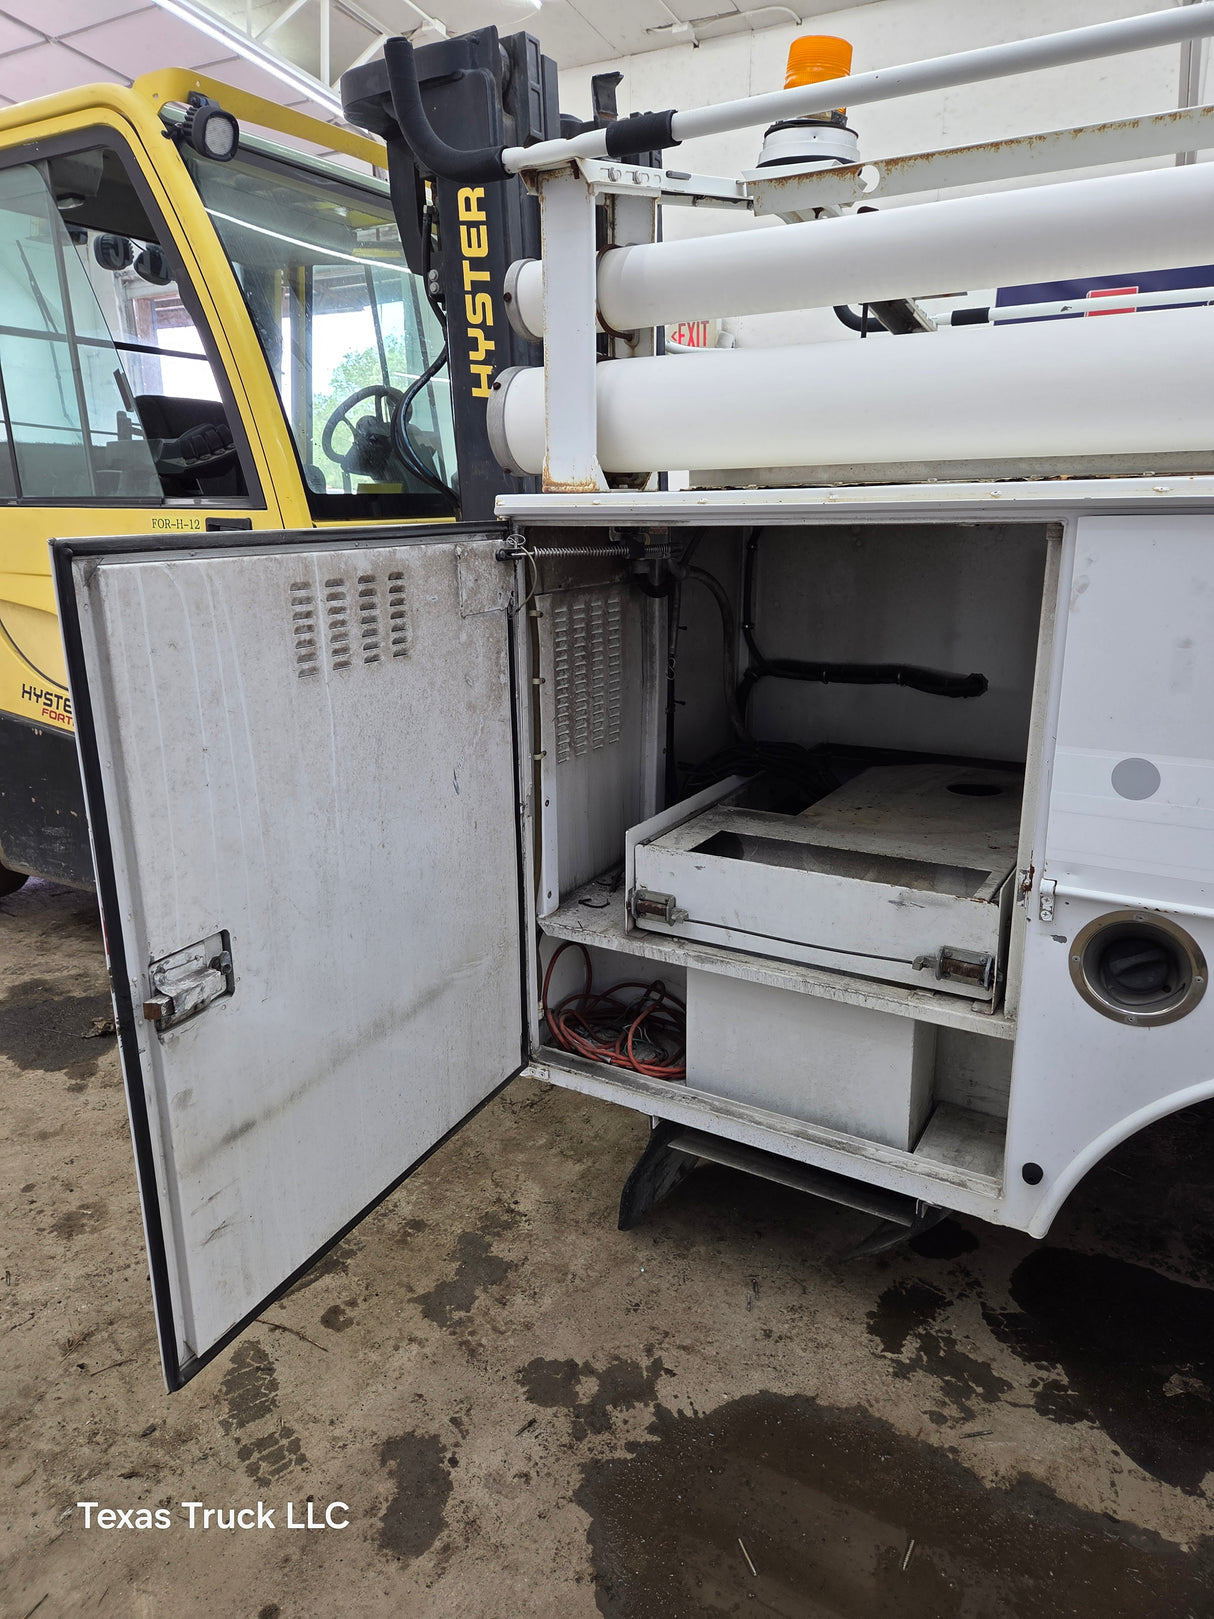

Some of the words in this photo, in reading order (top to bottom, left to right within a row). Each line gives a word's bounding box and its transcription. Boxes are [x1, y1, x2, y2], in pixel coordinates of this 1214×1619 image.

[457, 186, 496, 398] HYSTER
[678, 320, 709, 348] EXIT
[151, 518, 201, 530] FOR-H-12
[41, 707, 75, 728] FORT
